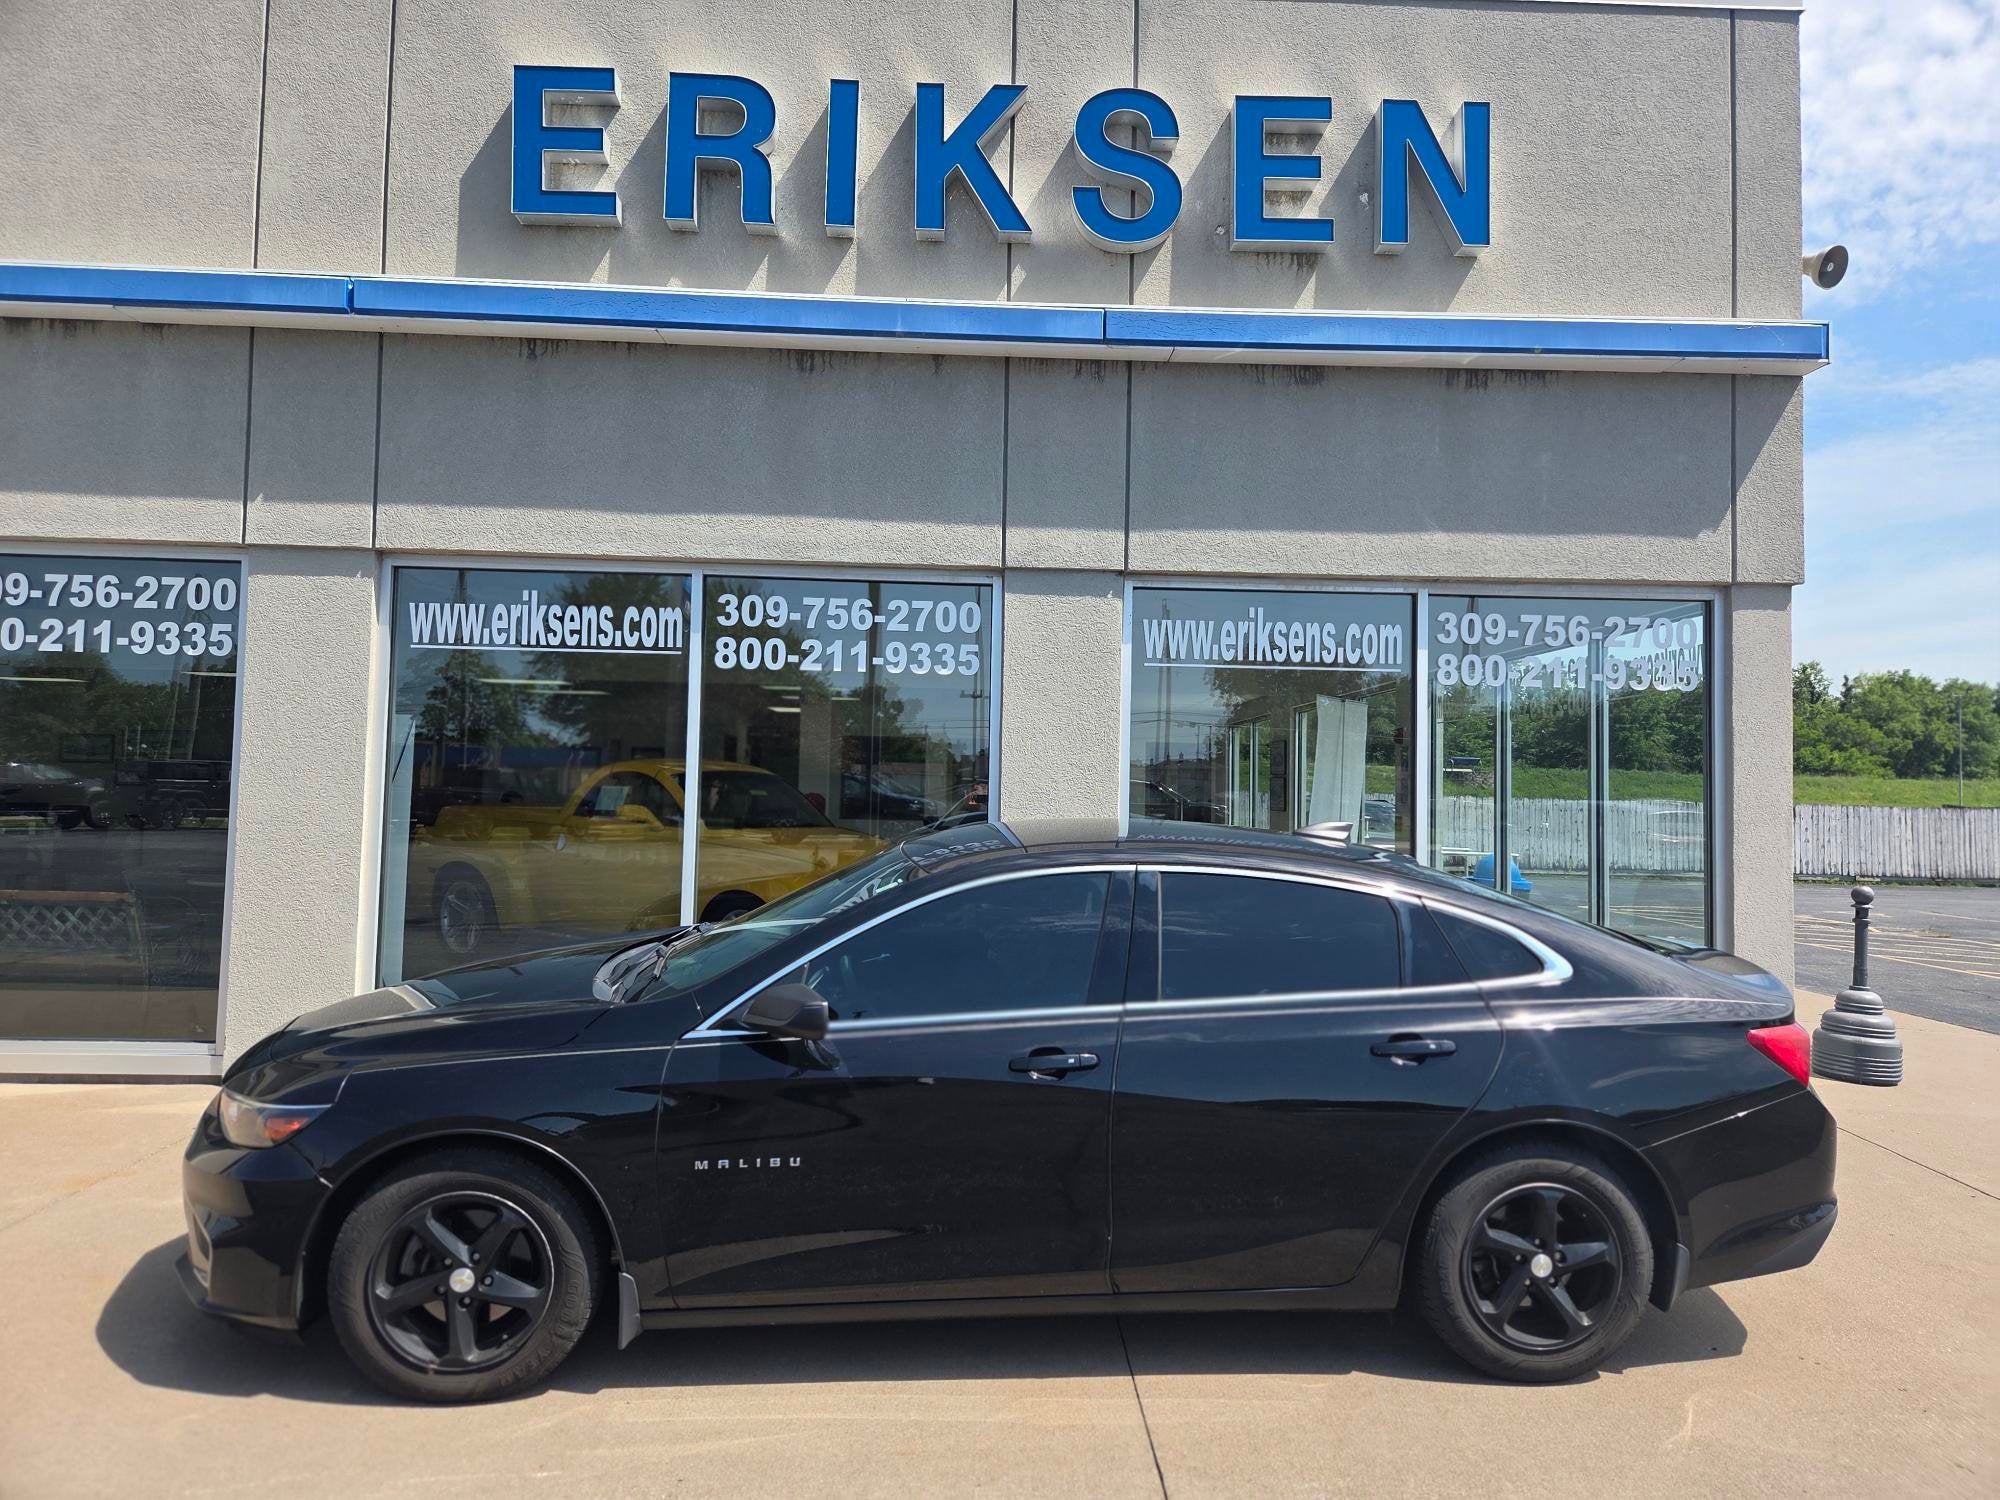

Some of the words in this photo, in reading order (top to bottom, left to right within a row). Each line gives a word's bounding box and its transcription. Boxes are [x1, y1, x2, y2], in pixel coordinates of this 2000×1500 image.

[511, 64, 1491, 254] ERIKSEN
[0, 572, 237, 611] 9-756-2700
[409, 589, 683, 648] www.eriksens.com
[716, 593, 981, 633] 309-756-2700
[1436, 611, 1698, 649] 309-756-2700
[1143, 606, 1403, 664] www.eriksens.com
[714, 636, 980, 675] 800-211-9335
[1436, 653, 1699, 692] 800-211-9335
[694, 1157, 801, 1170] MALIBU
